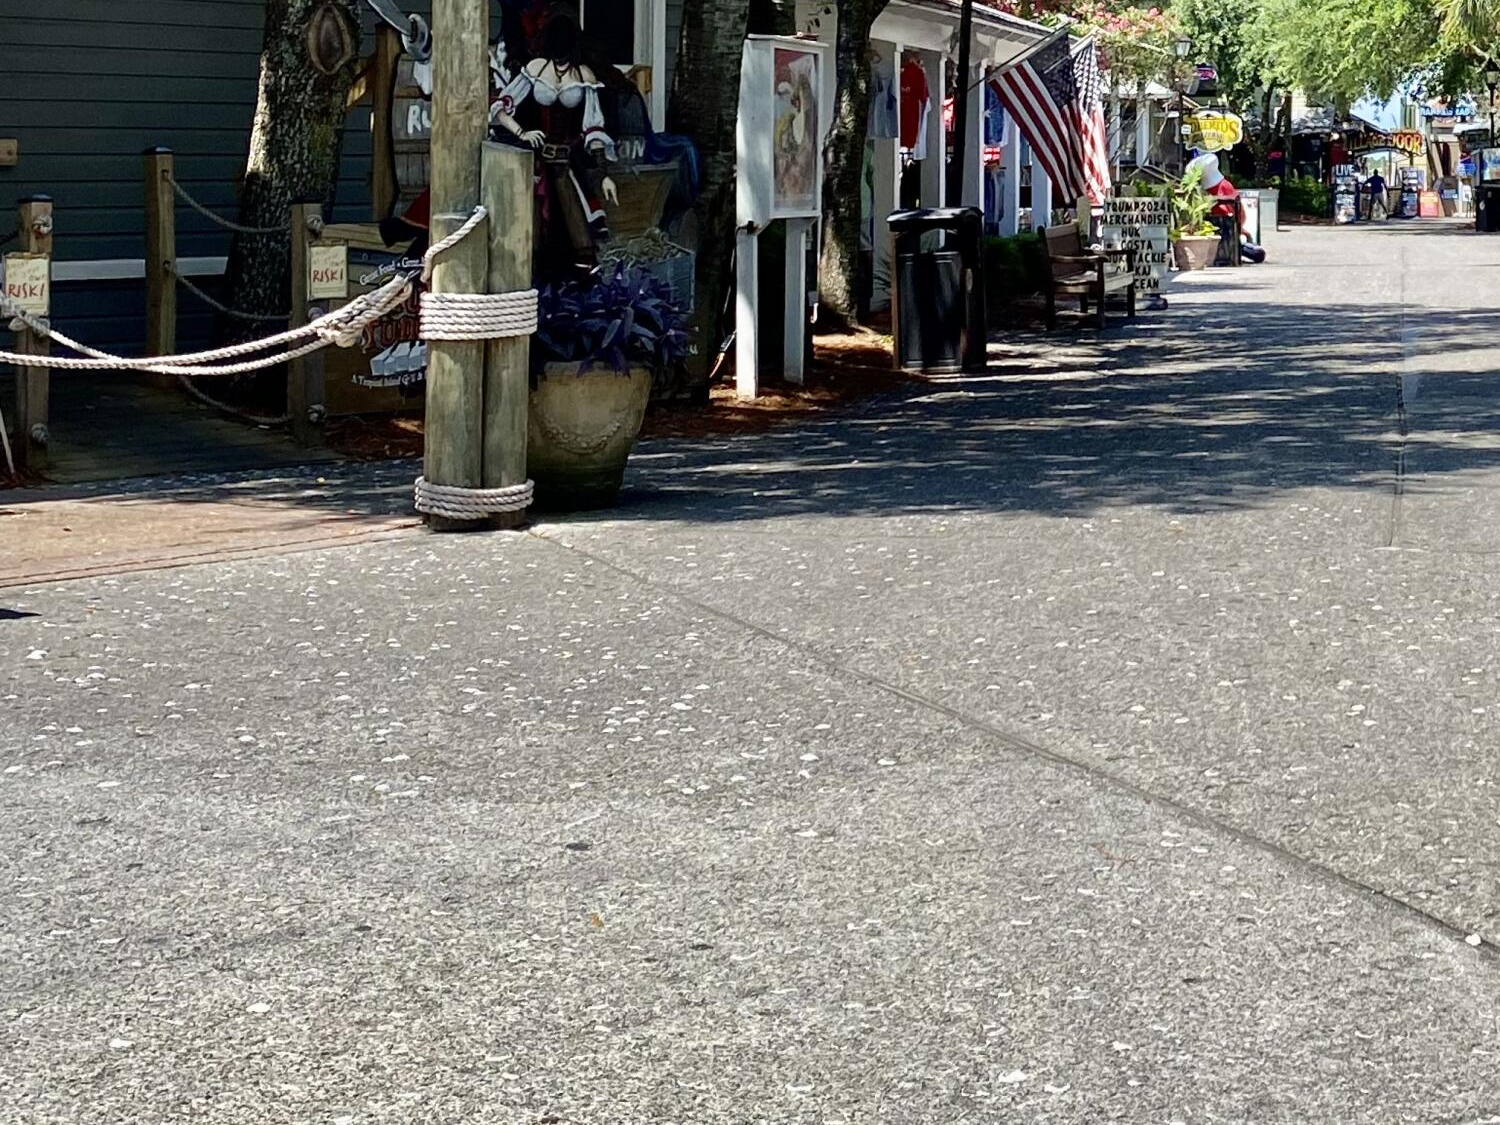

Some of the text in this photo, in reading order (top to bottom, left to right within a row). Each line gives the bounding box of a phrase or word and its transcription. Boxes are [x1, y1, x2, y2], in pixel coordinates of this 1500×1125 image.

[1386, 132, 1423, 156] DOOR
[1335, 164, 1355, 176] LIVE
[1101, 214, 1169, 225] MERCHANDISE
[1121, 226, 1141, 238] HUK
[1120, 239, 1153, 251] COSTA
